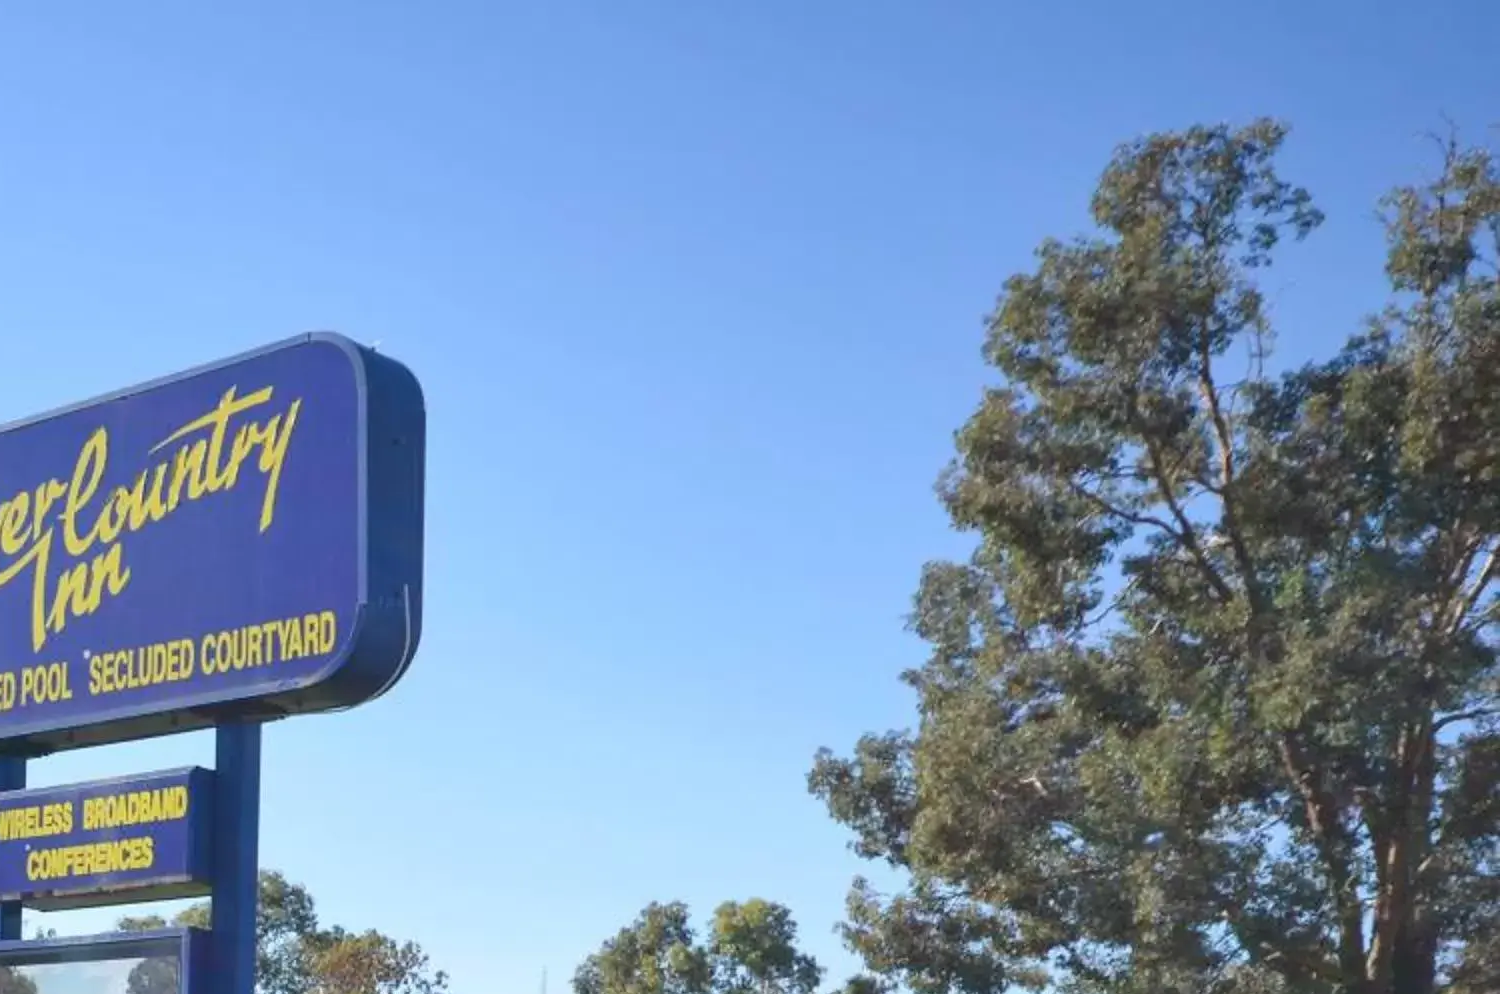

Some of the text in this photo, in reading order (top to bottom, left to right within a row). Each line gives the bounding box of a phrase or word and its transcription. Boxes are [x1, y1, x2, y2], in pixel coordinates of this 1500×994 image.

[32, 526, 131, 654] Inn
[20, 662, 72, 706] POOL
[89, 639, 194, 695] SECLUDED
[201, 610, 336, 675] COURTYARD
[83, 786, 188, 830] BROADBAND
[27, 837, 154, 881] CONFERENCES
